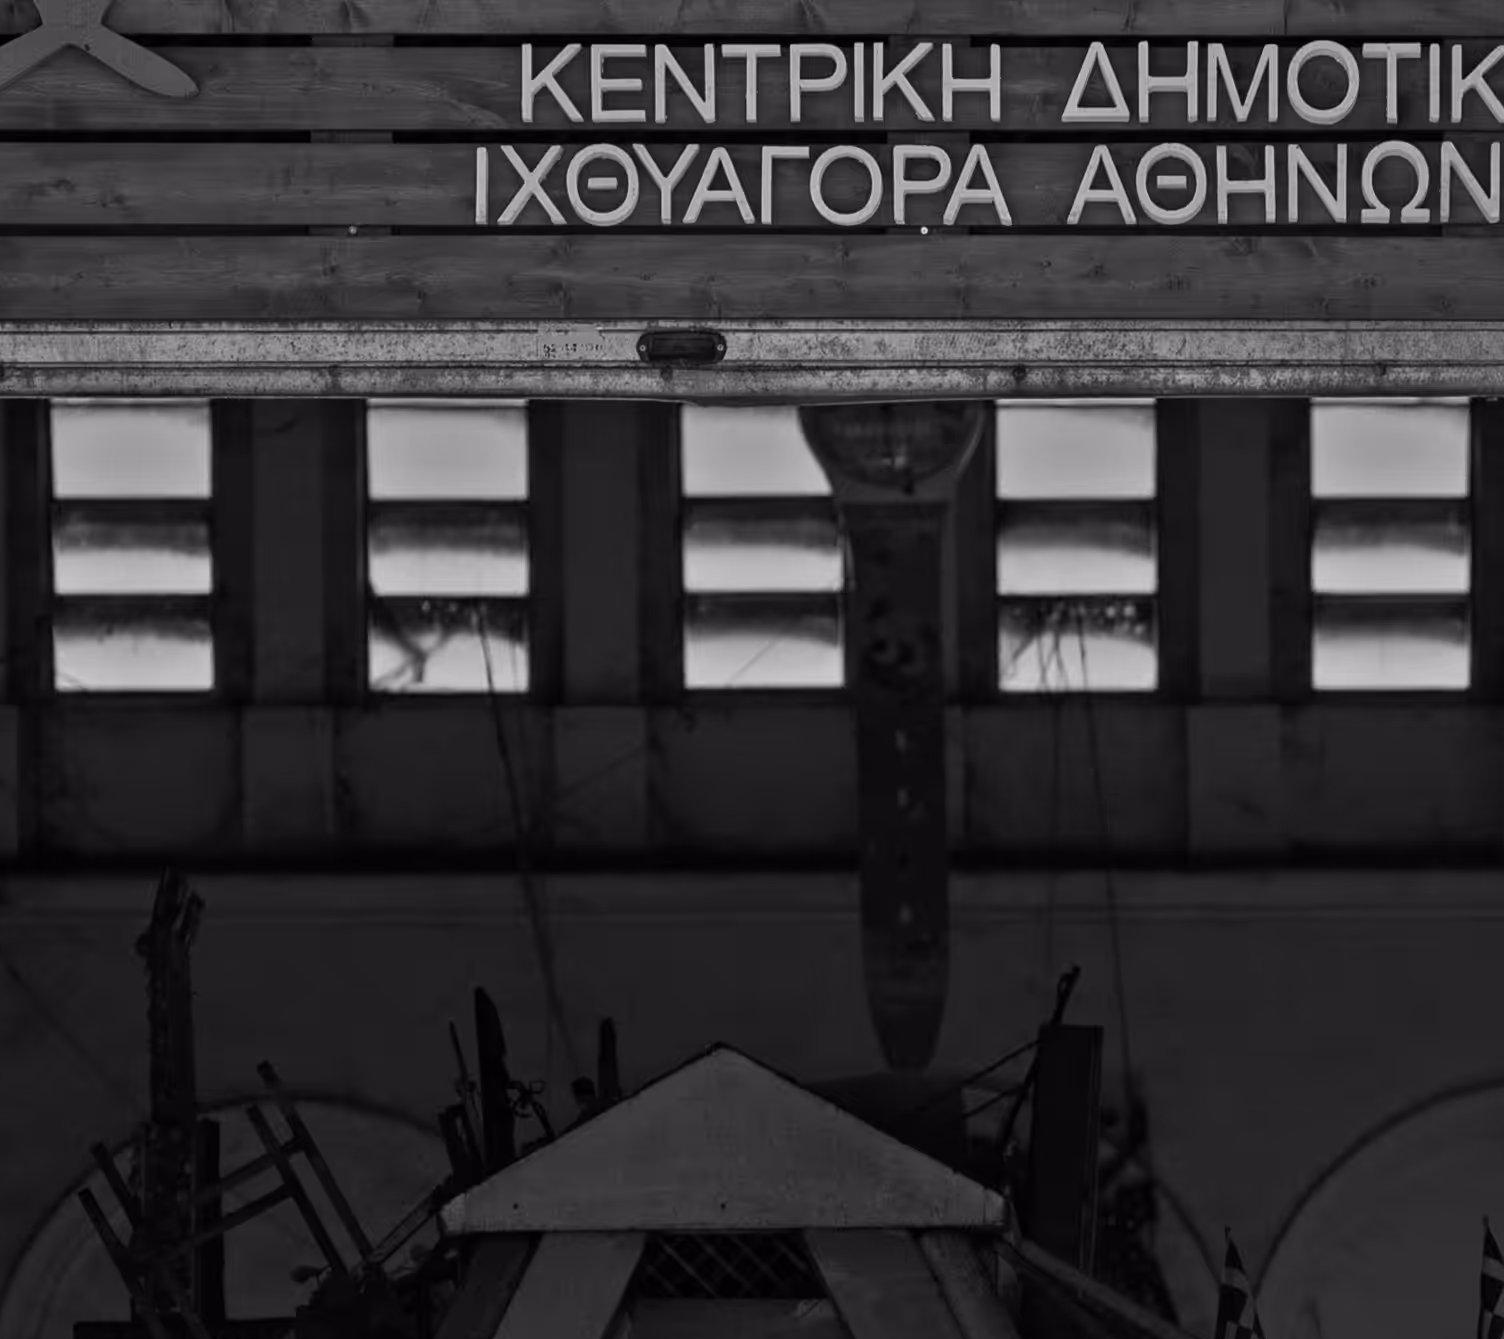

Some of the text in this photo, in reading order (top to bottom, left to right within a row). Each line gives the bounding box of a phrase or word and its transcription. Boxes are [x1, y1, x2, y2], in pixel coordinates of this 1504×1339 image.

[518, 44, 1002, 126] ΚΕΝΤΡΙΚΗ
[475, 142, 1504, 230] ΙΧΘΥΑΓΟΡΑ ΑΘΗΝΩΝ
